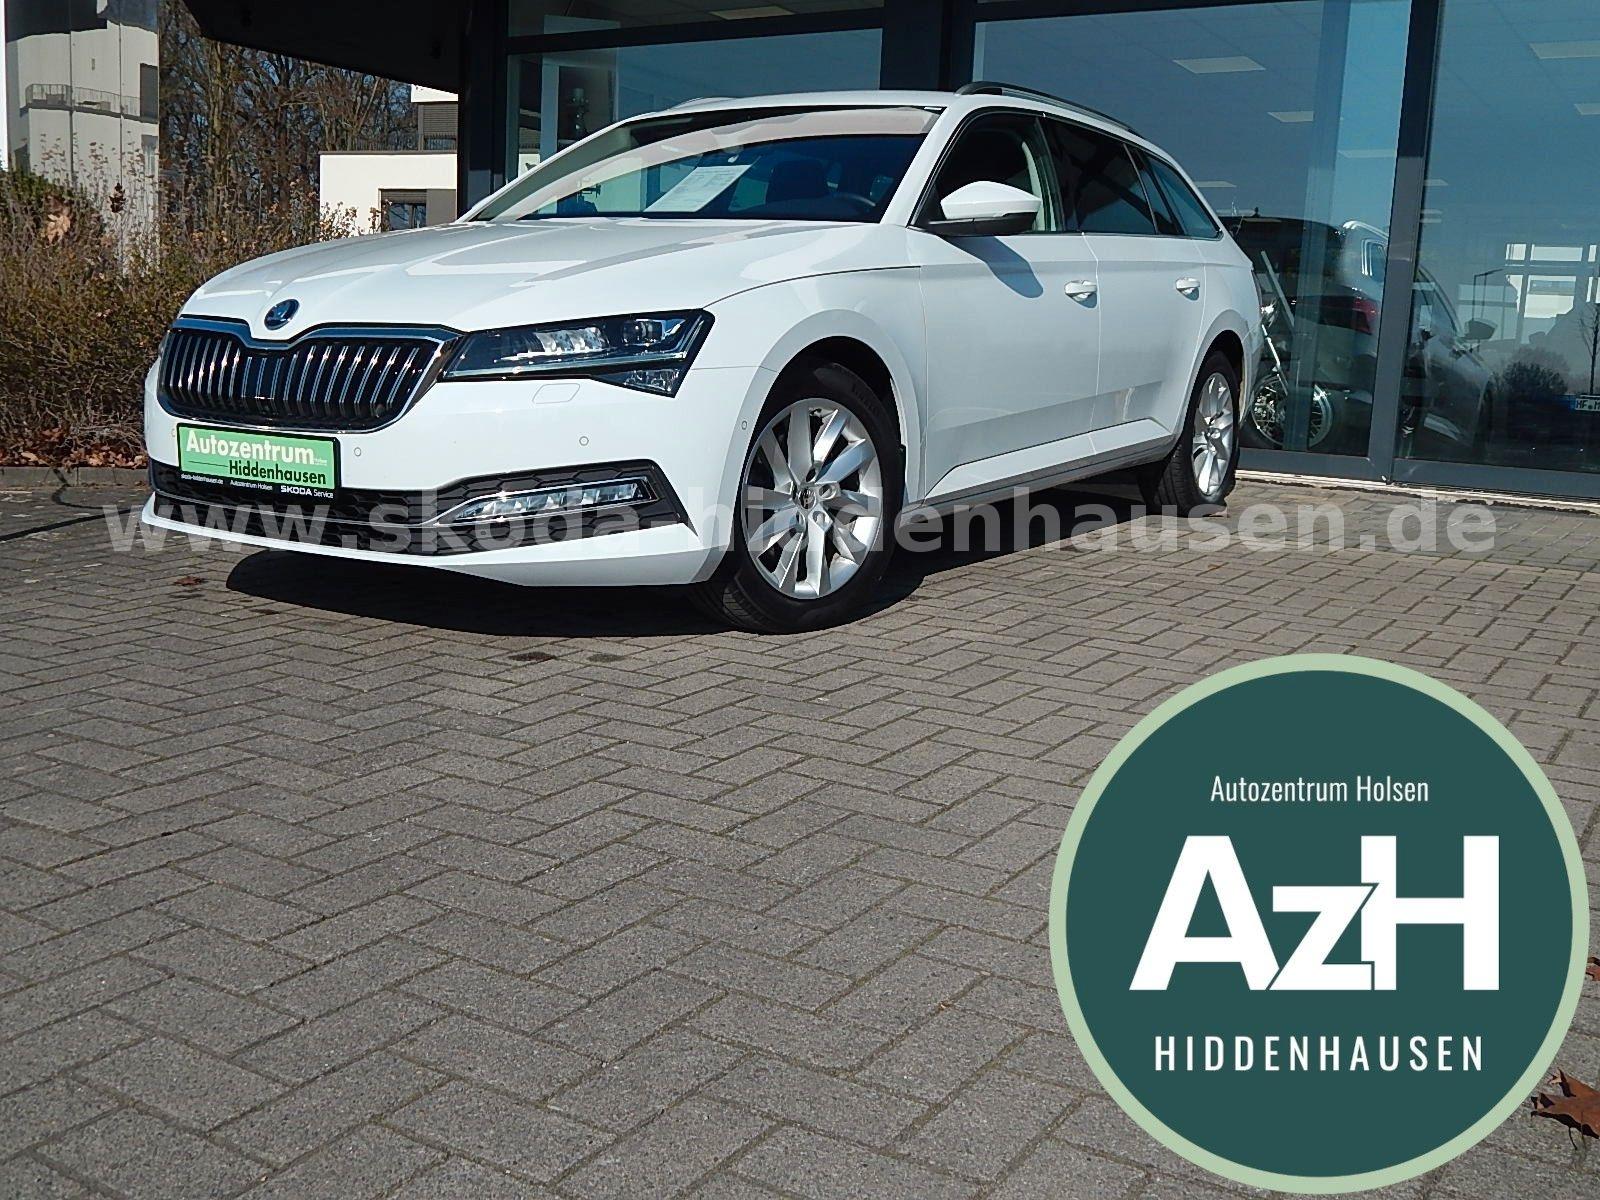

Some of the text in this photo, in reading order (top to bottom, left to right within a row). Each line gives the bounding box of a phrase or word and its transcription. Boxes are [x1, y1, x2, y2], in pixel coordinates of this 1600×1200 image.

[186, 430, 314, 465] Autozentrum
[229, 460, 326, 485] Hiddenhausen
[230, 480, 257, 489] Autozentrum
[257, 483, 273, 491] Holsen
[313, 489, 334, 499] Service
